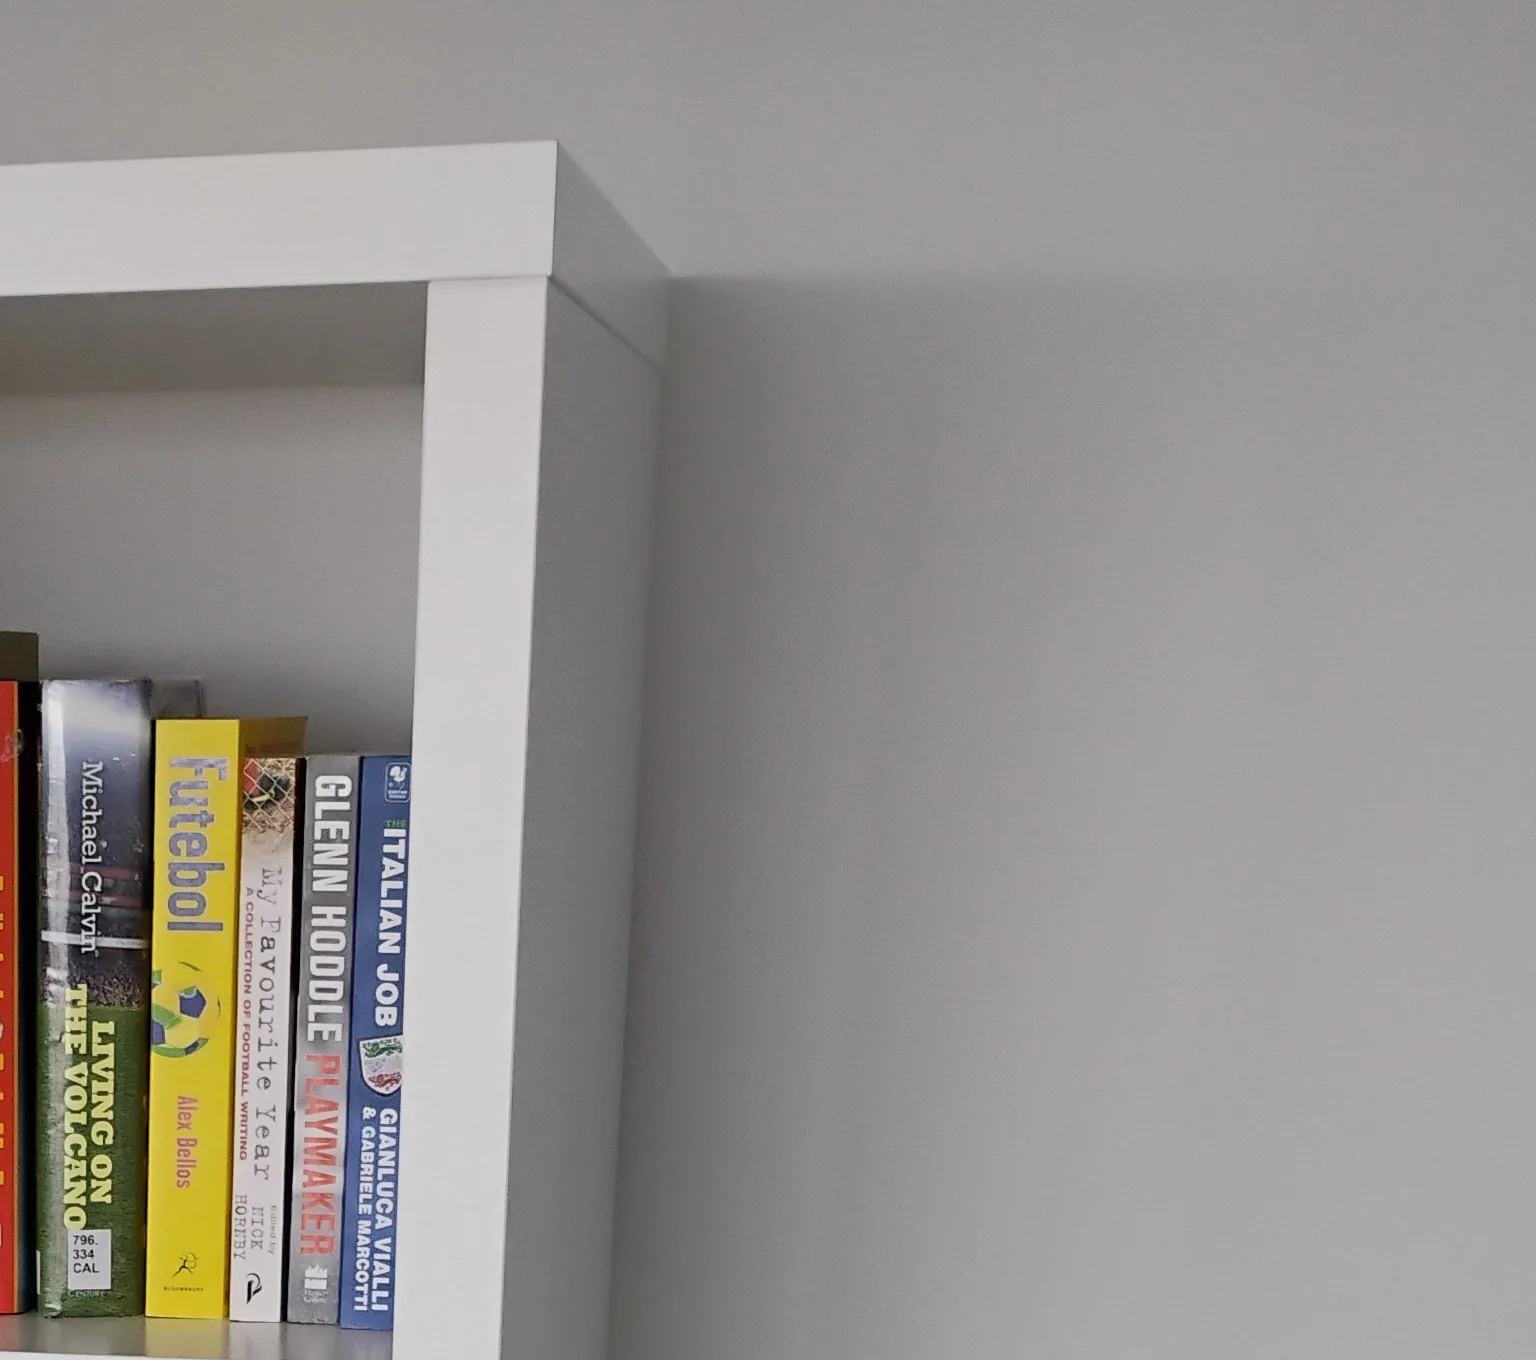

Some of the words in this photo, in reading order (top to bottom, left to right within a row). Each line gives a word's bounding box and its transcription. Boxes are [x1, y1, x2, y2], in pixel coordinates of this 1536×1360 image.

[81, 761, 104, 864] Michael
[167, 758, 228, 931] Futebol
[312, 775, 353, 892] GLENN
[80, 871, 102, 953] Calvin
[246, 887, 254, 897] A
[257, 868, 283, 906] My
[378, 828, 407, 954] ITALIAN
[244, 901, 254, 995] COLLECTION
[306, 906, 346, 1042] HODDLE
[65, 983, 88, 1055] THE
[242, 999, 252, 1019] OF
[256, 917, 281, 1090] Favourite
[375, 963, 400, 1027] JOB
[91, 1020, 115, 1146] LIVING
[241, 1023, 251, 1097] FOOTBALL
[63, 1061, 88, 1231] VOLCANO
[177, 1096, 199, 1131] Alex
[239, 1101, 249, 1161] WRITING
[254, 1104, 277, 1180] Year
[362, 1106, 376, 1120] &
[90, 1154, 113, 1204] ON
[176, 1137, 198, 1188] Bellos
[300, 1054, 341, 1255] PLAYMAKER
[358, 1127, 376, 1215] GABRIELE
[375, 1108, 398, 1229] GIANLUCA
[72, 1235, 98, 1246] 796.
[72, 1249, 94, 1260] 334
[233, 1194, 247, 1260] HORNBY
[250, 1206, 264, 1250] NICK
[72, 1262, 100, 1274] CAL
[354, 1220, 372, 1312] MARCOTTI
[370, 1237, 392, 1311] VIALLI
